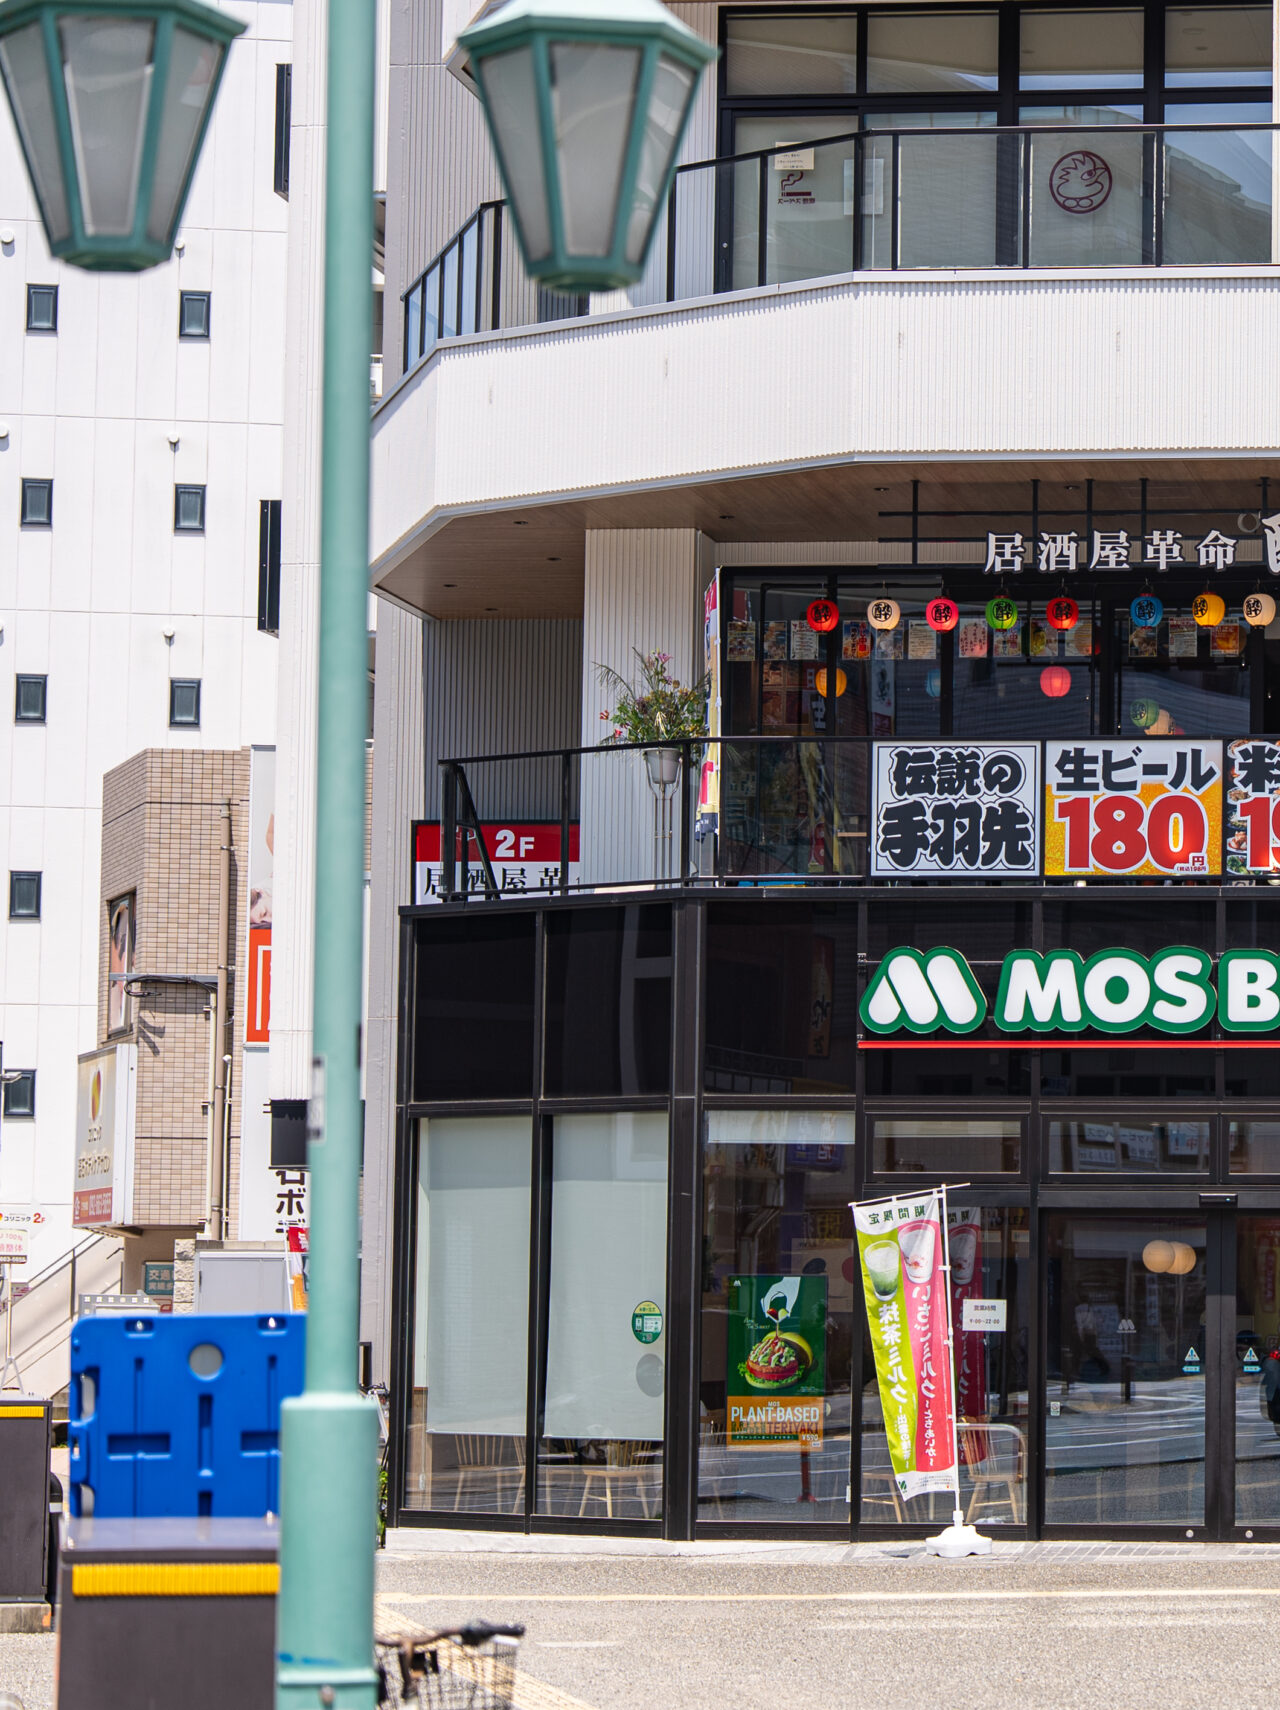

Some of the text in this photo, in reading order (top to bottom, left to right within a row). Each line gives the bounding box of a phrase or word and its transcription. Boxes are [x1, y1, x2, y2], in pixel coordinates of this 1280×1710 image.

[985, 530, 1237, 573] 居酒屋革命
[893, 750, 1022, 797] 伝説の
[1055, 747, 1217, 792] 生ビール
[495, 829, 535, 858] 2F
[880, 800, 1034, 868] 手羽先
[1058, 796, 1206, 871] 180 円
[1003, 955, 1207, 1024] MOS
[731, 1406, 820, 1422] PLANT-BASED
[767, 1421, 819, 1434] TERIYAKI
